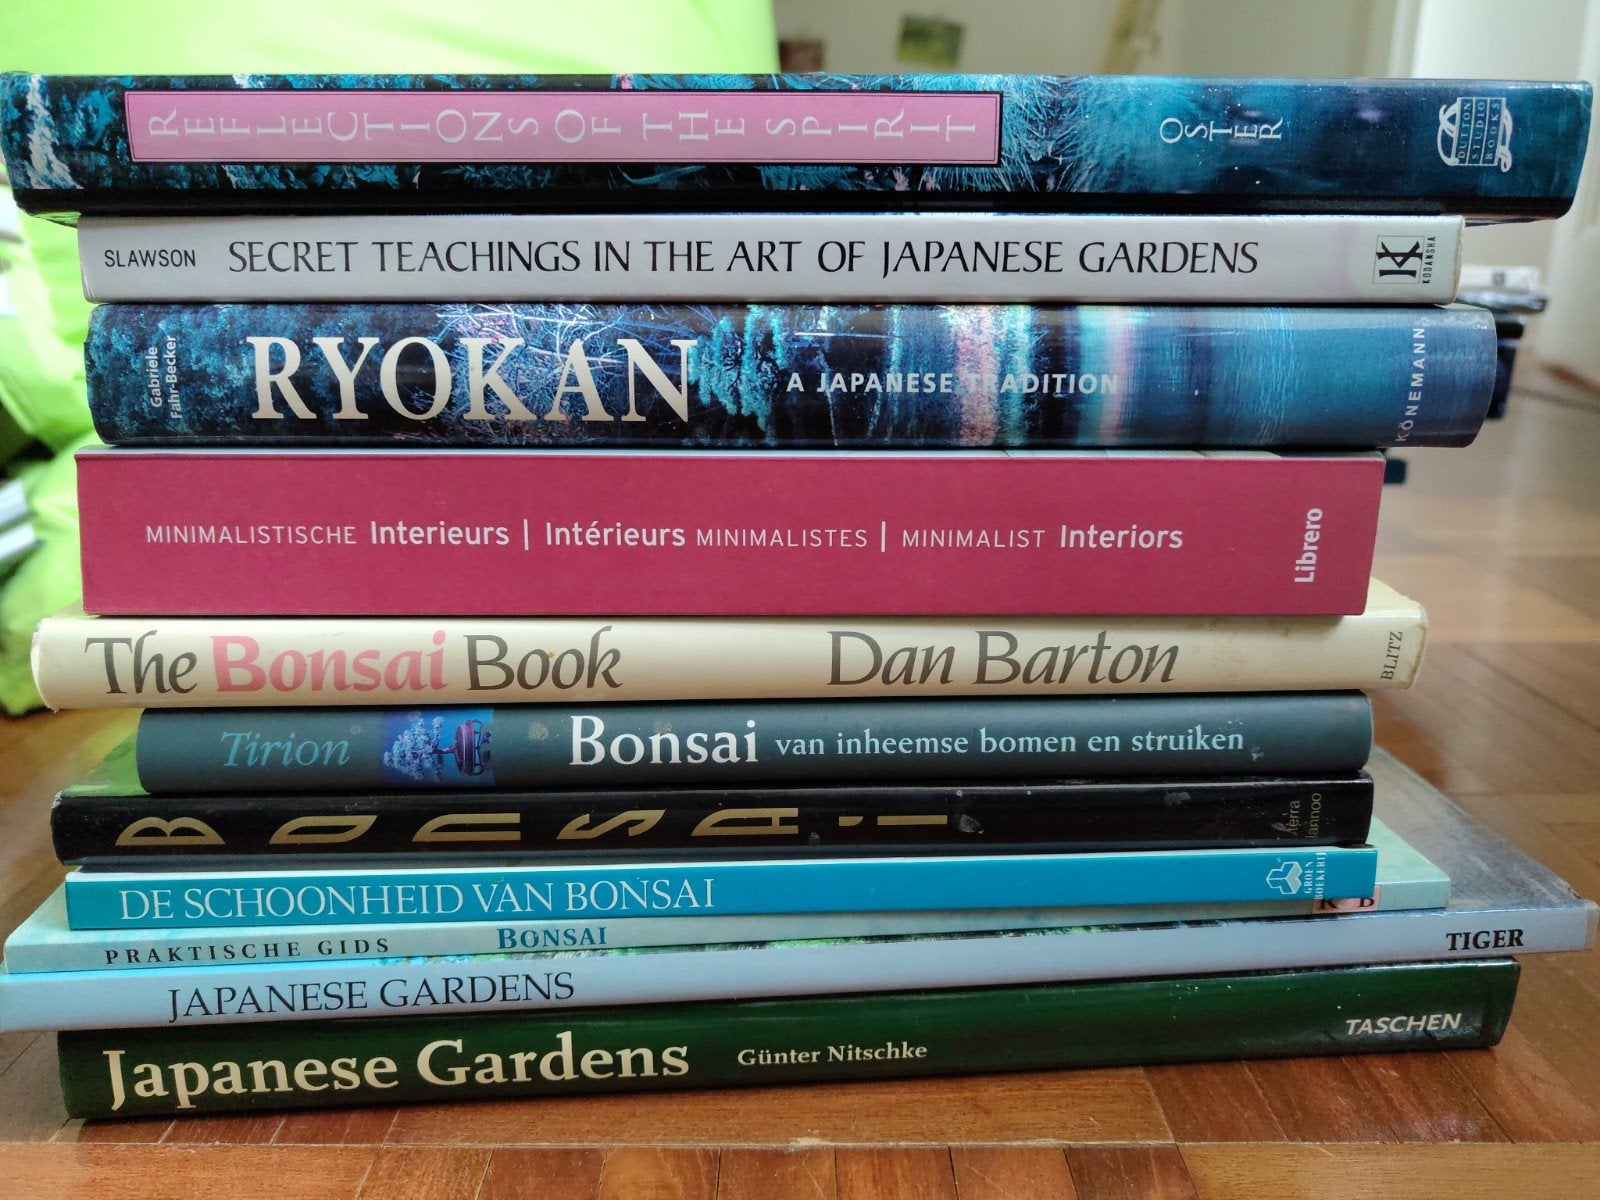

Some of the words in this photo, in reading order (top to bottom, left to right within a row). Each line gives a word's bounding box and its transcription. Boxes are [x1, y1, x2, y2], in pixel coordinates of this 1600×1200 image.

[149, 106, 539, 143] REFLECTIONS
[555, 108, 621, 143] OF
[642, 110, 745, 142] THE
[766, 108, 976, 142] SPIRIT
[1159, 117, 1283, 144] OSTER
[1457, 102, 1471, 158] DUTTON
[1472, 101, 1485, 159] STUDIO
[1485, 103, 1500, 159] BOOKS
[104, 248, 196, 267] SLAWSON
[228, 241, 358, 272] SECRET
[372, 240, 580, 273] TEACHINGS
[594, 241, 630, 272] IN
[645, 241, 714, 272] THE
[726, 241, 801, 272] ART
[817, 241, 866, 272] OF
[882, 241, 1064, 279] JAPANESE
[1078, 241, 1259, 273] GARDENS
[1421, 237, 1436, 284] KODANSHA
[145, 347, 163, 407] Gabriele
[163, 335, 182, 419] Fahr-Becker
[246, 336, 697, 422] RYOKAN
[786, 373, 804, 392] A
[816, 372, 952, 393] JAPANESE
[967, 373, 1118, 394] TRADITION
[1395, 328, 1426, 442] KÖNEMANN
[146, 525, 357, 545] MINIMALISTISCHE
[370, 520, 509, 546] Interieurs
[546, 521, 686, 547] Intérieurs
[696, 528, 867, 548] MINIMALISTES
[902, 529, 1045, 548] MINIMALIST
[1060, 524, 1183, 549] Interiors
[1294, 507, 1323, 583] Librero
[85, 629, 197, 694] The
[211, 630, 447, 693] Bonsai
[464, 625, 622, 692] Book
[828, 631, 954, 686] Dan
[974, 630, 1179, 685] Barton
[1380, 631, 1402, 680] BLITZ
[220, 731, 349, 767] Tirion
[570, 715, 757, 765] Bonsai
[775, 736, 824, 757] van
[836, 727, 969, 755] inheemse
[980, 727, 1077, 754] bomen
[1087, 734, 1121, 753] en
[1131, 724, 1244, 752] struiken
[1288, 800, 1301, 833] terra
[1305, 793, 1321, 838] lannoo
[120, 889, 173, 920] DE
[185, 884, 464, 919] SCHOONHEID
[472, 881, 555, 912] VAN
[565, 878, 715, 912] BONSAI
[1304, 861, 1314, 894] GROEN
[105, 940, 301, 965] PRAKTISCHE
[317, 938, 390, 956] GIDS
[498, 926, 607, 950] BONSAI
[1446, 929, 1524, 951] TIGER
[169, 980, 368, 1023] JAPANESE
[380, 971, 575, 1008] GARDENS
[1346, 1012, 1462, 1036] TASCHEN
[103, 1045, 399, 1112] Japanese
[417, 1031, 690, 1088] Gardens
[737, 1049, 821, 1065] Günter
[827, 1041, 928, 1062] Nitschke
